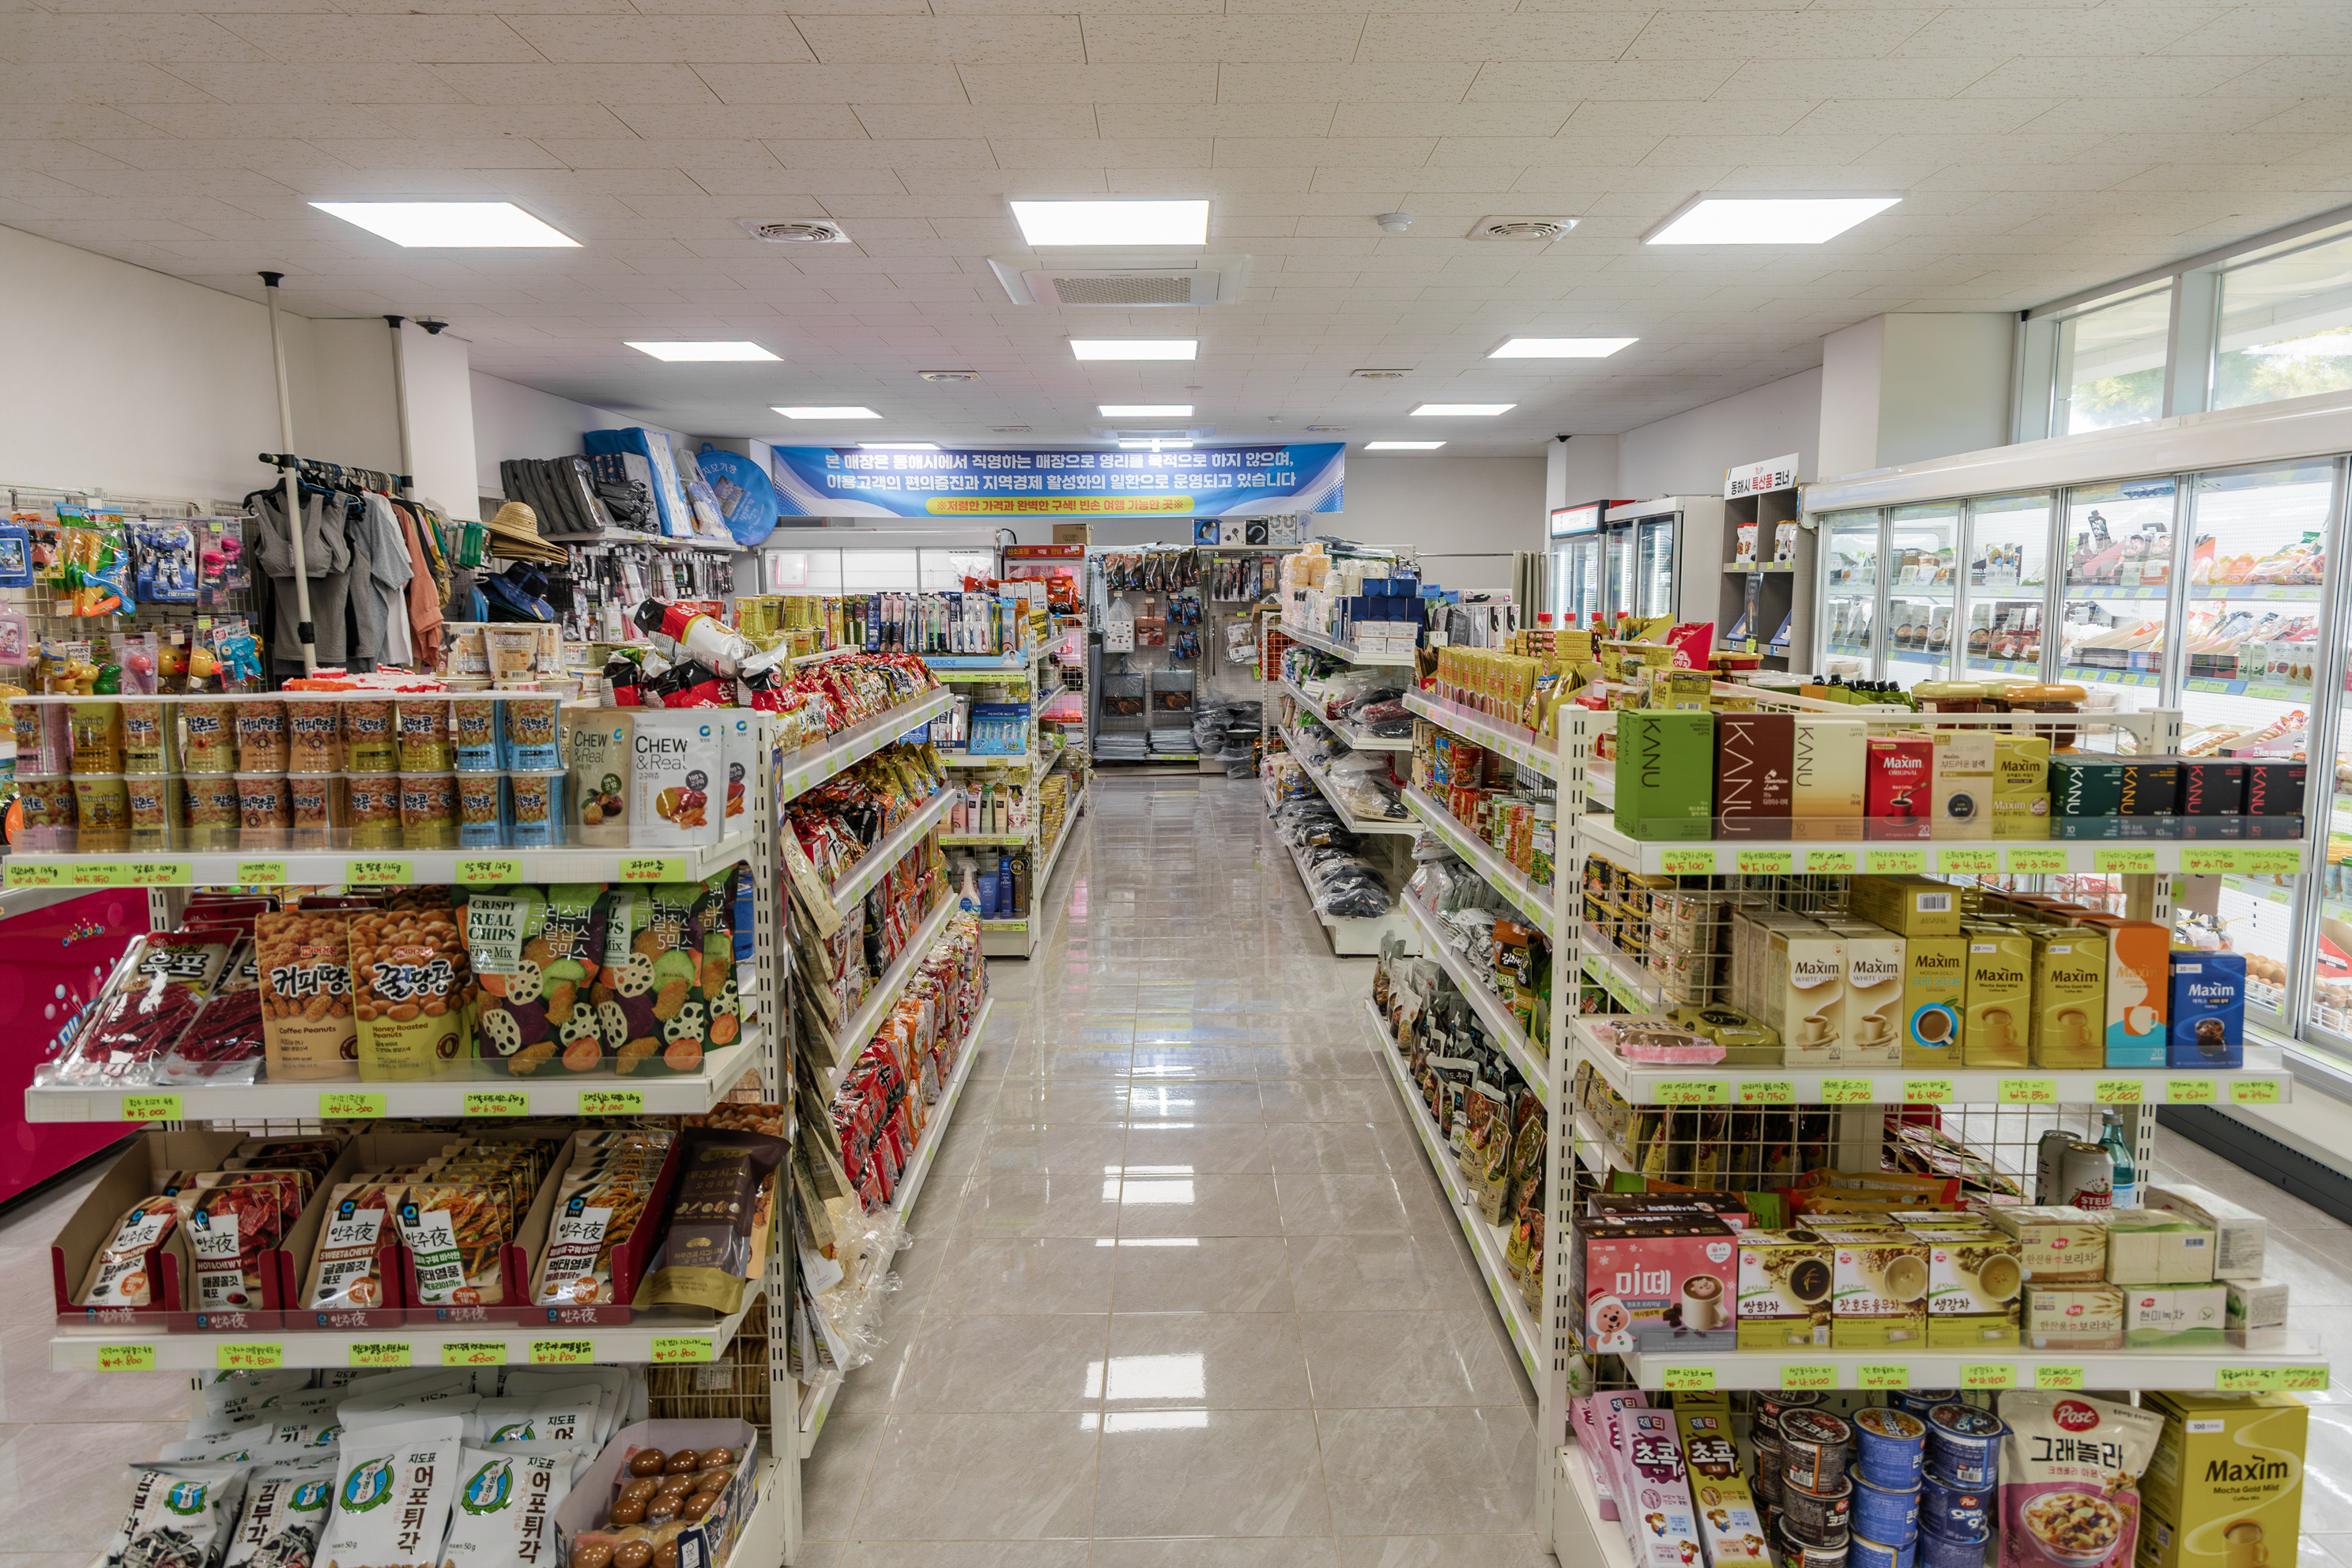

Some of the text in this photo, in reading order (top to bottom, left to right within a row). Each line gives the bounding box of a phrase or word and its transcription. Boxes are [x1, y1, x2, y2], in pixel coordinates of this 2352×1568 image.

[825, 451, 1294, 469] 본 매장은 동해시에서 직영하는 매장으로 영리를 목적으로 하지 않으며,
[827, 472, 1295, 490] 이용고객의 편의증진과 지역경제 활성화의 일환으로 운영되고 있습니다
[1731, 469, 1789, 496] 동해시 특산품 코너
[982, 500, 1014, 511] 가격과
[1017, 500, 1049, 511] 완벽한
[1052, 500, 1076, 511] 구색!
[1080, 500, 1101, 511] 빈손
[1104, 500, 1125, 511] 여행
[1128, 499, 1159, 511] 가능한
[240, 715, 284, 732] 커피땅콩
[294, 715, 337, 732] 커피땅콩
[458, 716, 486, 732] 알땅콩
[520, 716, 550, 731] 알땅콩
[574, 730, 608, 748] CHEW
[635, 736, 688, 753] CHEW
[575, 748, 605, 763] &Real
[1642, 718, 1661, 788] KANU
[1796, 727, 1815, 787] KANU
[636, 753, 688, 771] &Real
[1883, 754, 1923, 769] Maxim
[2000, 759, 2041, 771] Maxim
[1721, 722, 1755, 834] KANU
[2066, 766, 2084, 815] KANU
[2120, 767, 2138, 814] KANU
[2188, 765, 2204, 813] KANU
[2250, 767, 2267, 815] KANU
[463, 794, 492, 809] 알땅콩
[1993, 798, 2026, 811] Maxim
[471, 899, 518, 912] CRISPY
[636, 895, 692, 916] 크리스피
[471, 913, 514, 928] REAL
[529, 902, 592, 925] 크리스피
[637, 913, 692, 933] 리얼칩스
[468, 927, 516, 942] CHIPS
[528, 921, 591, 943] 리얼칩스
[657, 929, 693, 951] 5믹스
[469, 945, 513, 959] Five Mix
[547, 940, 589, 962] 5믹스
[138, 952, 209, 977] 육포
[1795, 959, 1840, 974] Maxim
[1853, 958, 1898, 974] Maxim
[1915, 953, 1960, 968] Maxim
[373, 959, 456, 1002] 꿀땅콩
[1912, 977, 1962, 986] ZERO SUGAR
[1975, 967, 2024, 982] Maxim
[2051, 968, 2098, 983] Maxim
[2188, 982, 2235, 997] Maxim
[279, 1025, 337, 1035] Coffee Peanuts
[372, 1022, 428, 1036] Honey Roasted
[373, 1030, 402, 1039] Peanuts
[319, 1246, 376, 1261] SWEET&CHEWY
[2026, 1251, 2097, 1265] 한잔용 보리차
[323, 1260, 367, 1276] 달콤쫄깃
[202, 1275, 239, 1290] 매콤쫄깃
[322, 1273, 341, 1285] 육포
[1615, 1263, 1672, 1296] 미떼
[202, 1288, 218, 1298] 육포
[1743, 1300, 1780, 1314] 쌍화차
[1934, 1298, 1970, 1312] 생강차
[2139, 1308, 2185, 1323] 현미녹차
[2040, 1318, 2114, 1332] 한잔용 보리차
[548, 1414, 576, 1427] 지도표
[2056, 1404, 2095, 1424] Post
[1636, 1415, 1665, 1431] 제티
[408, 1452, 436, 1464] 지도표
[2030, 1435, 2124, 1471] 그래놀라
[528, 1456, 556, 1470] 지도표
[2205, 1454, 2289, 1483] Maxim
[2213, 1483, 2279, 1494] Mocha Gold Mild
[247, 1483, 281, 1546] 김부각
[397, 1464, 435, 1555] 어포튀각
[517, 1470, 552, 1565] 어포튀각
[345, 1540, 358, 1550] 50g
[463, 1543, 477, 1553] 50g
